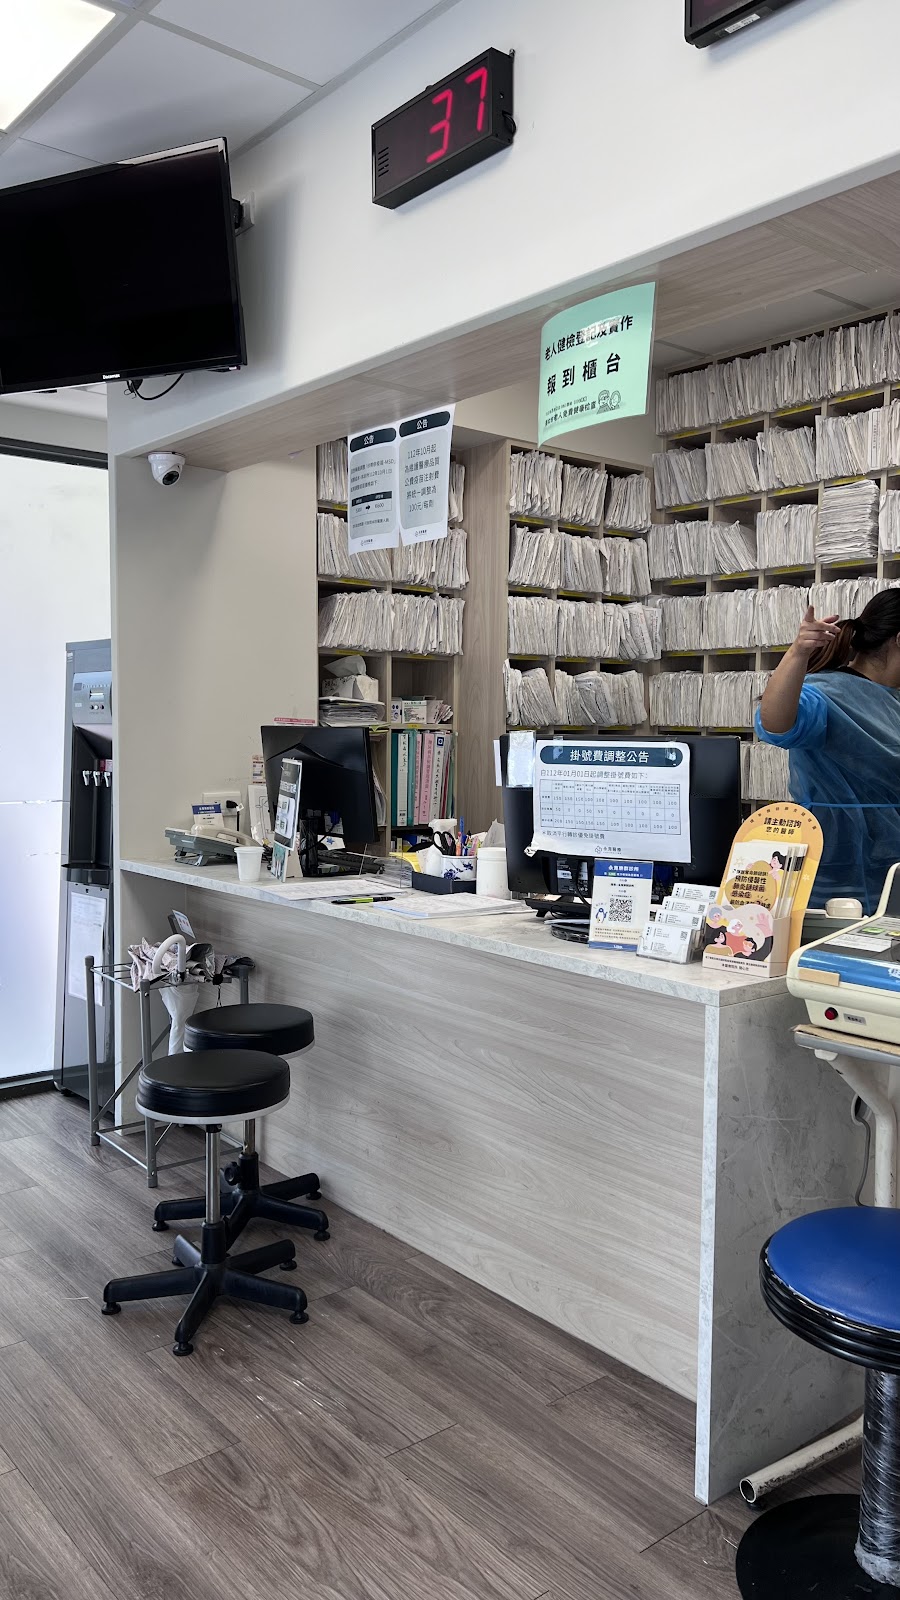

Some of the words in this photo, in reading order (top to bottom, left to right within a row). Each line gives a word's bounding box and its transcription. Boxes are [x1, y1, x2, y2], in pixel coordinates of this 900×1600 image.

[426, 65, 489, 164] 37
[547, 352, 621, 396] 報到櫃台
[416, 419, 428, 430] 公告
[363, 434, 375, 445] 公告
[407, 443, 437, 459] 112年10月起
[404, 471, 440, 487] 公費疫苗注射費
[570, 750, 650, 764] 掛號費調整公告
[763, 816, 802, 829] 請主動諮詢
[765, 826, 795, 836] 您的醫師
[735, 875, 767, 885] 預防侵襲性
[732, 882, 766, 893] 肺炎鏈球菌
[731, 890, 751, 899] 感染症
